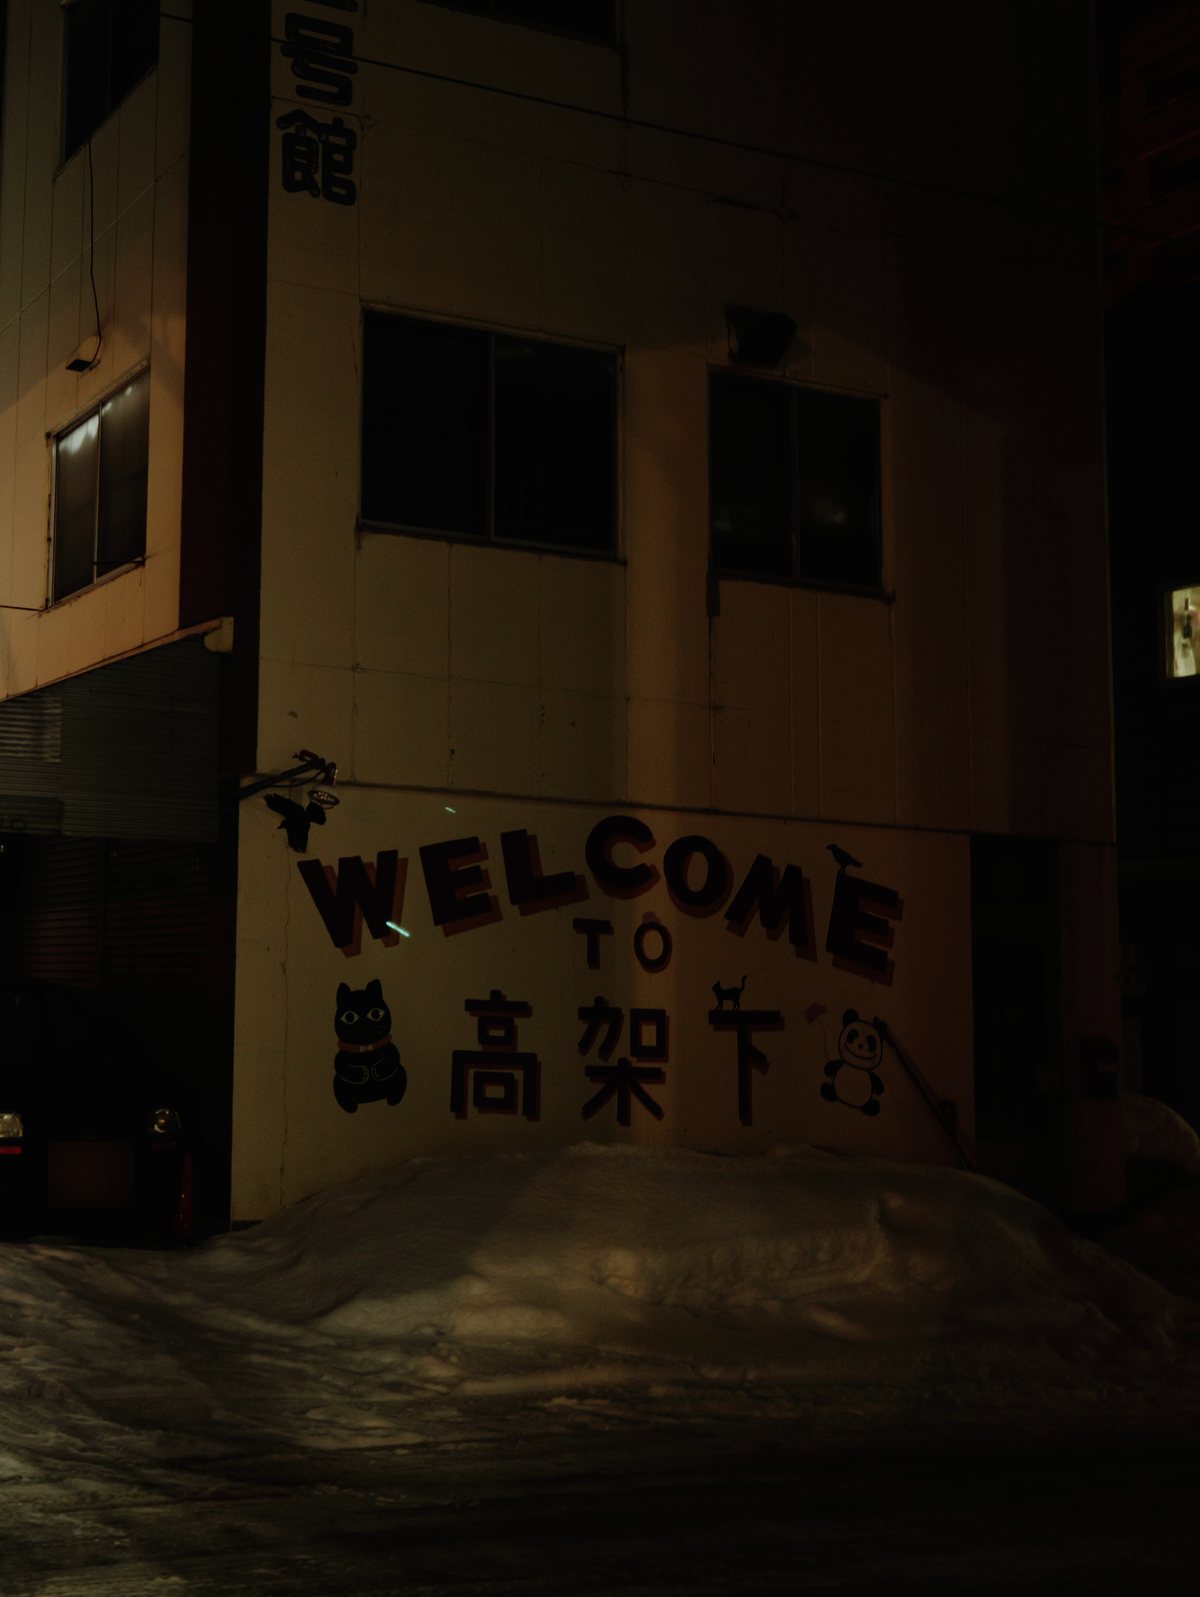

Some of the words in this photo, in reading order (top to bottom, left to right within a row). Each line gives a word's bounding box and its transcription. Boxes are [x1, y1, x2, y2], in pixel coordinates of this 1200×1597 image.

[276, 0, 357, 205] 号館
[298, 815, 904, 985] WELCOME
[573, 918, 672, 972] TO
[450, 990, 784, 1125] 高架下
